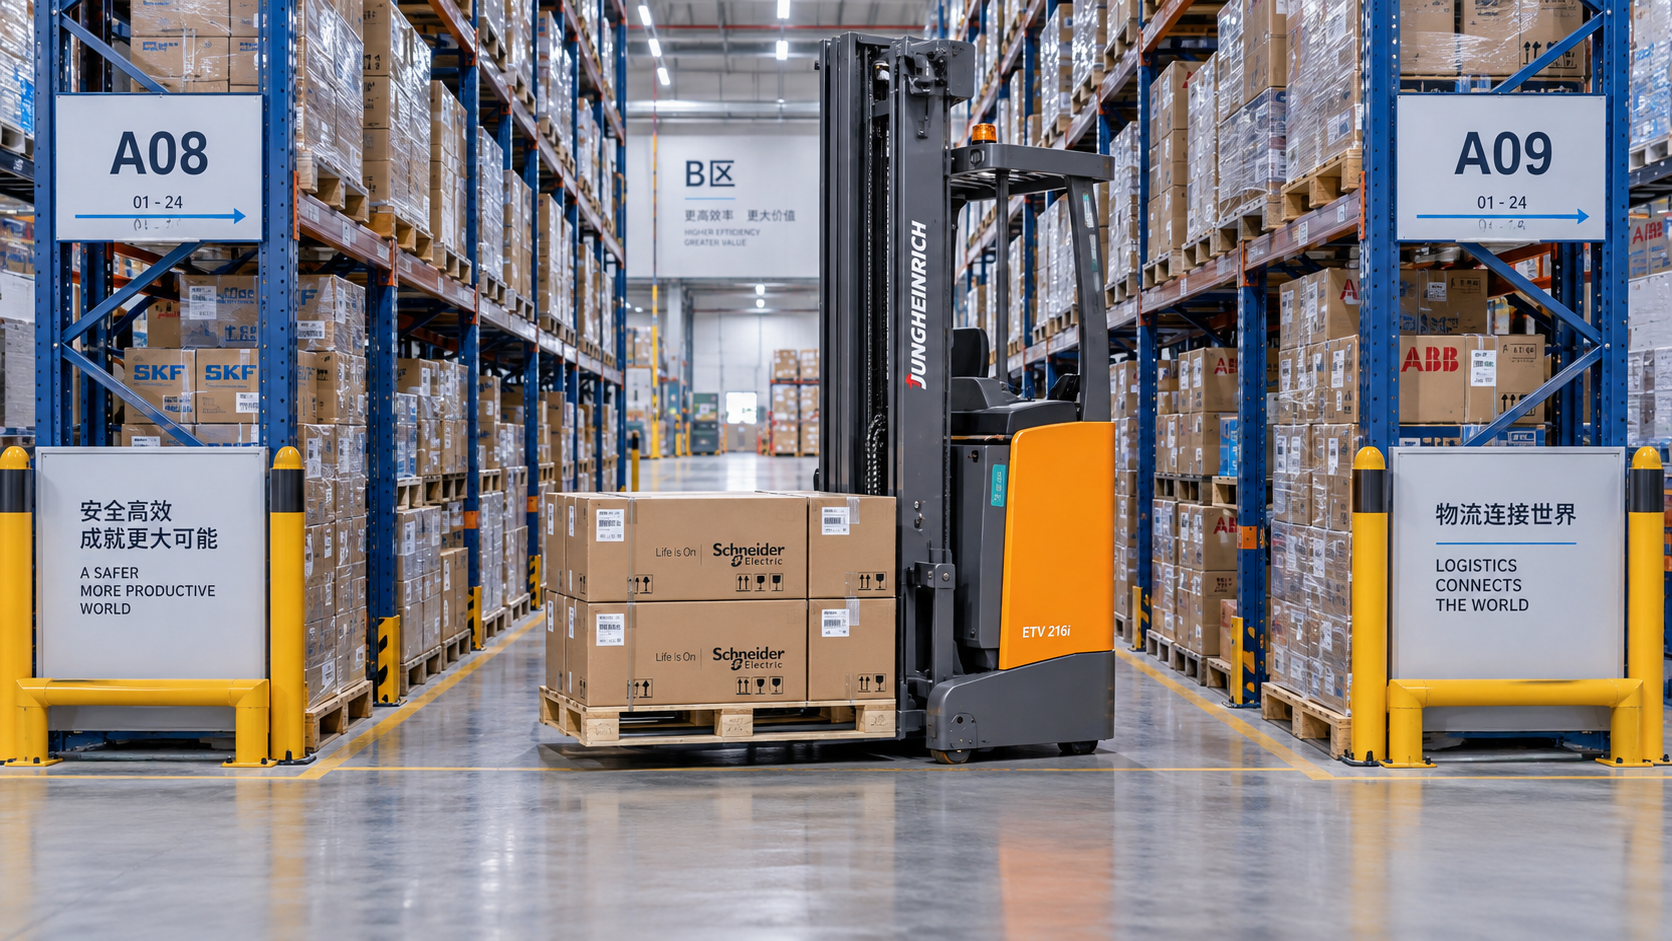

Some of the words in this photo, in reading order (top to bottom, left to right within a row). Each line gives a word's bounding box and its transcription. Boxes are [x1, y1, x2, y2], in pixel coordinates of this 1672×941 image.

[110, 131, 208, 175] A08
[1455, 131, 1553, 175] A09
[133, 195, 149, 209] 01
[165, 195, 183, 209] 24
[1477, 195, 1493, 209] 01
[1509, 195, 1527, 209] 24
[685, 209, 734, 222] 更高效率
[747, 209, 796, 222] 更大价值
[684, 239, 720, 247] GREATER
[722, 239, 747, 247] VALUE
[906, 220, 927, 390] JUNGHEINRICH
[1213, 357, 1238, 374] AB
[1401, 346, 1459, 373] ABB
[133, 365, 186, 380] SKF
[205, 365, 257, 380] SKF
[80, 499, 173, 523] 安全高效
[1436, 502, 1577, 526] 物流连接世界
[1213, 515, 1237, 534] AB
[80, 526, 218, 550] 成就更大可能
[655, 547, 672, 557] Life
[683, 547, 697, 557] On
[713, 542, 785, 556] Schneider
[744, 557, 783, 566] Electric
[1436, 558, 1518, 573] LOGISTICS
[80, 566, 90, 579] A
[94, 566, 139, 579] SAFER
[80, 584, 122, 597] MORE
[126, 584, 216, 597] PRODUCTIVE
[1436, 578, 1522, 592] CONNECTS
[80, 602, 131, 615] WORLD
[1436, 598, 1467, 611] THE
[1472, 598, 1529, 611] WORLD
[1022, 626, 1046, 638] ETV
[1048, 625, 1071, 637] 216i
[655, 652, 672, 662] Life
[683, 651, 696, 662] On
[713, 646, 785, 660] Schneider
[744, 661, 783, 669] Electric
